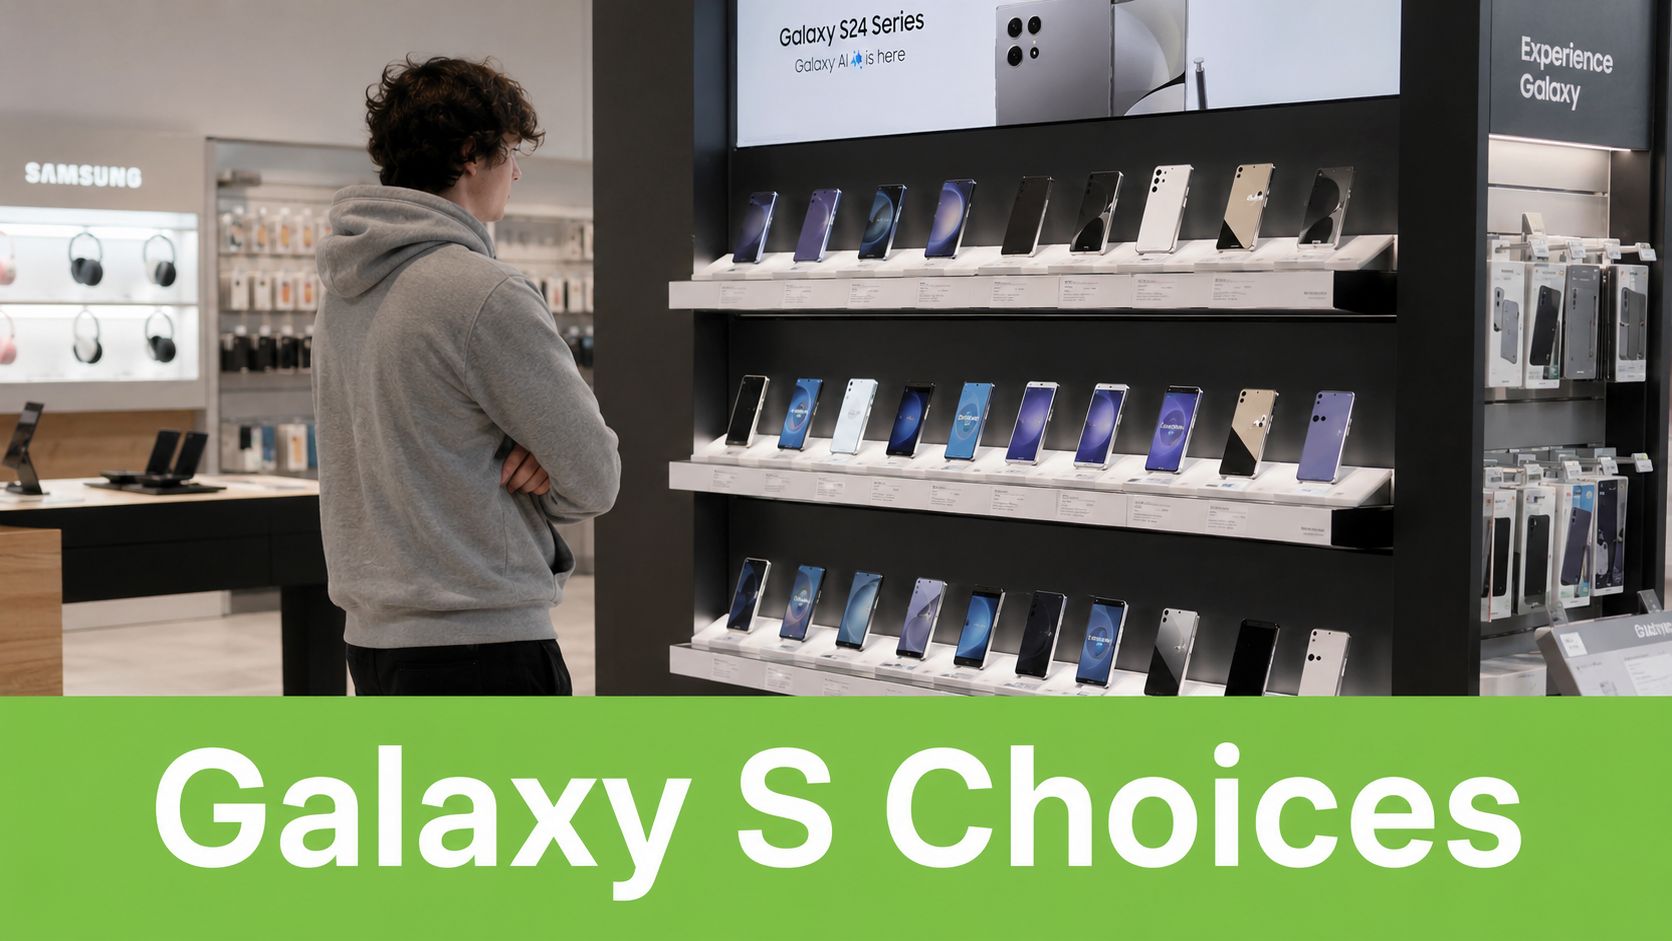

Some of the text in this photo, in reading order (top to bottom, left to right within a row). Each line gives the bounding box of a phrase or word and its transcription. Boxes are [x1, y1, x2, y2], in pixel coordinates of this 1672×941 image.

[779, 10, 925, 47] Galaxy S24 Series
[794, 48, 906, 74] Galaxy AI is here
[1521, 35, 1614, 74] Experience
[1520, 73, 1581, 111] Galaxy
[24, 161, 142, 188] SAMSUNG
